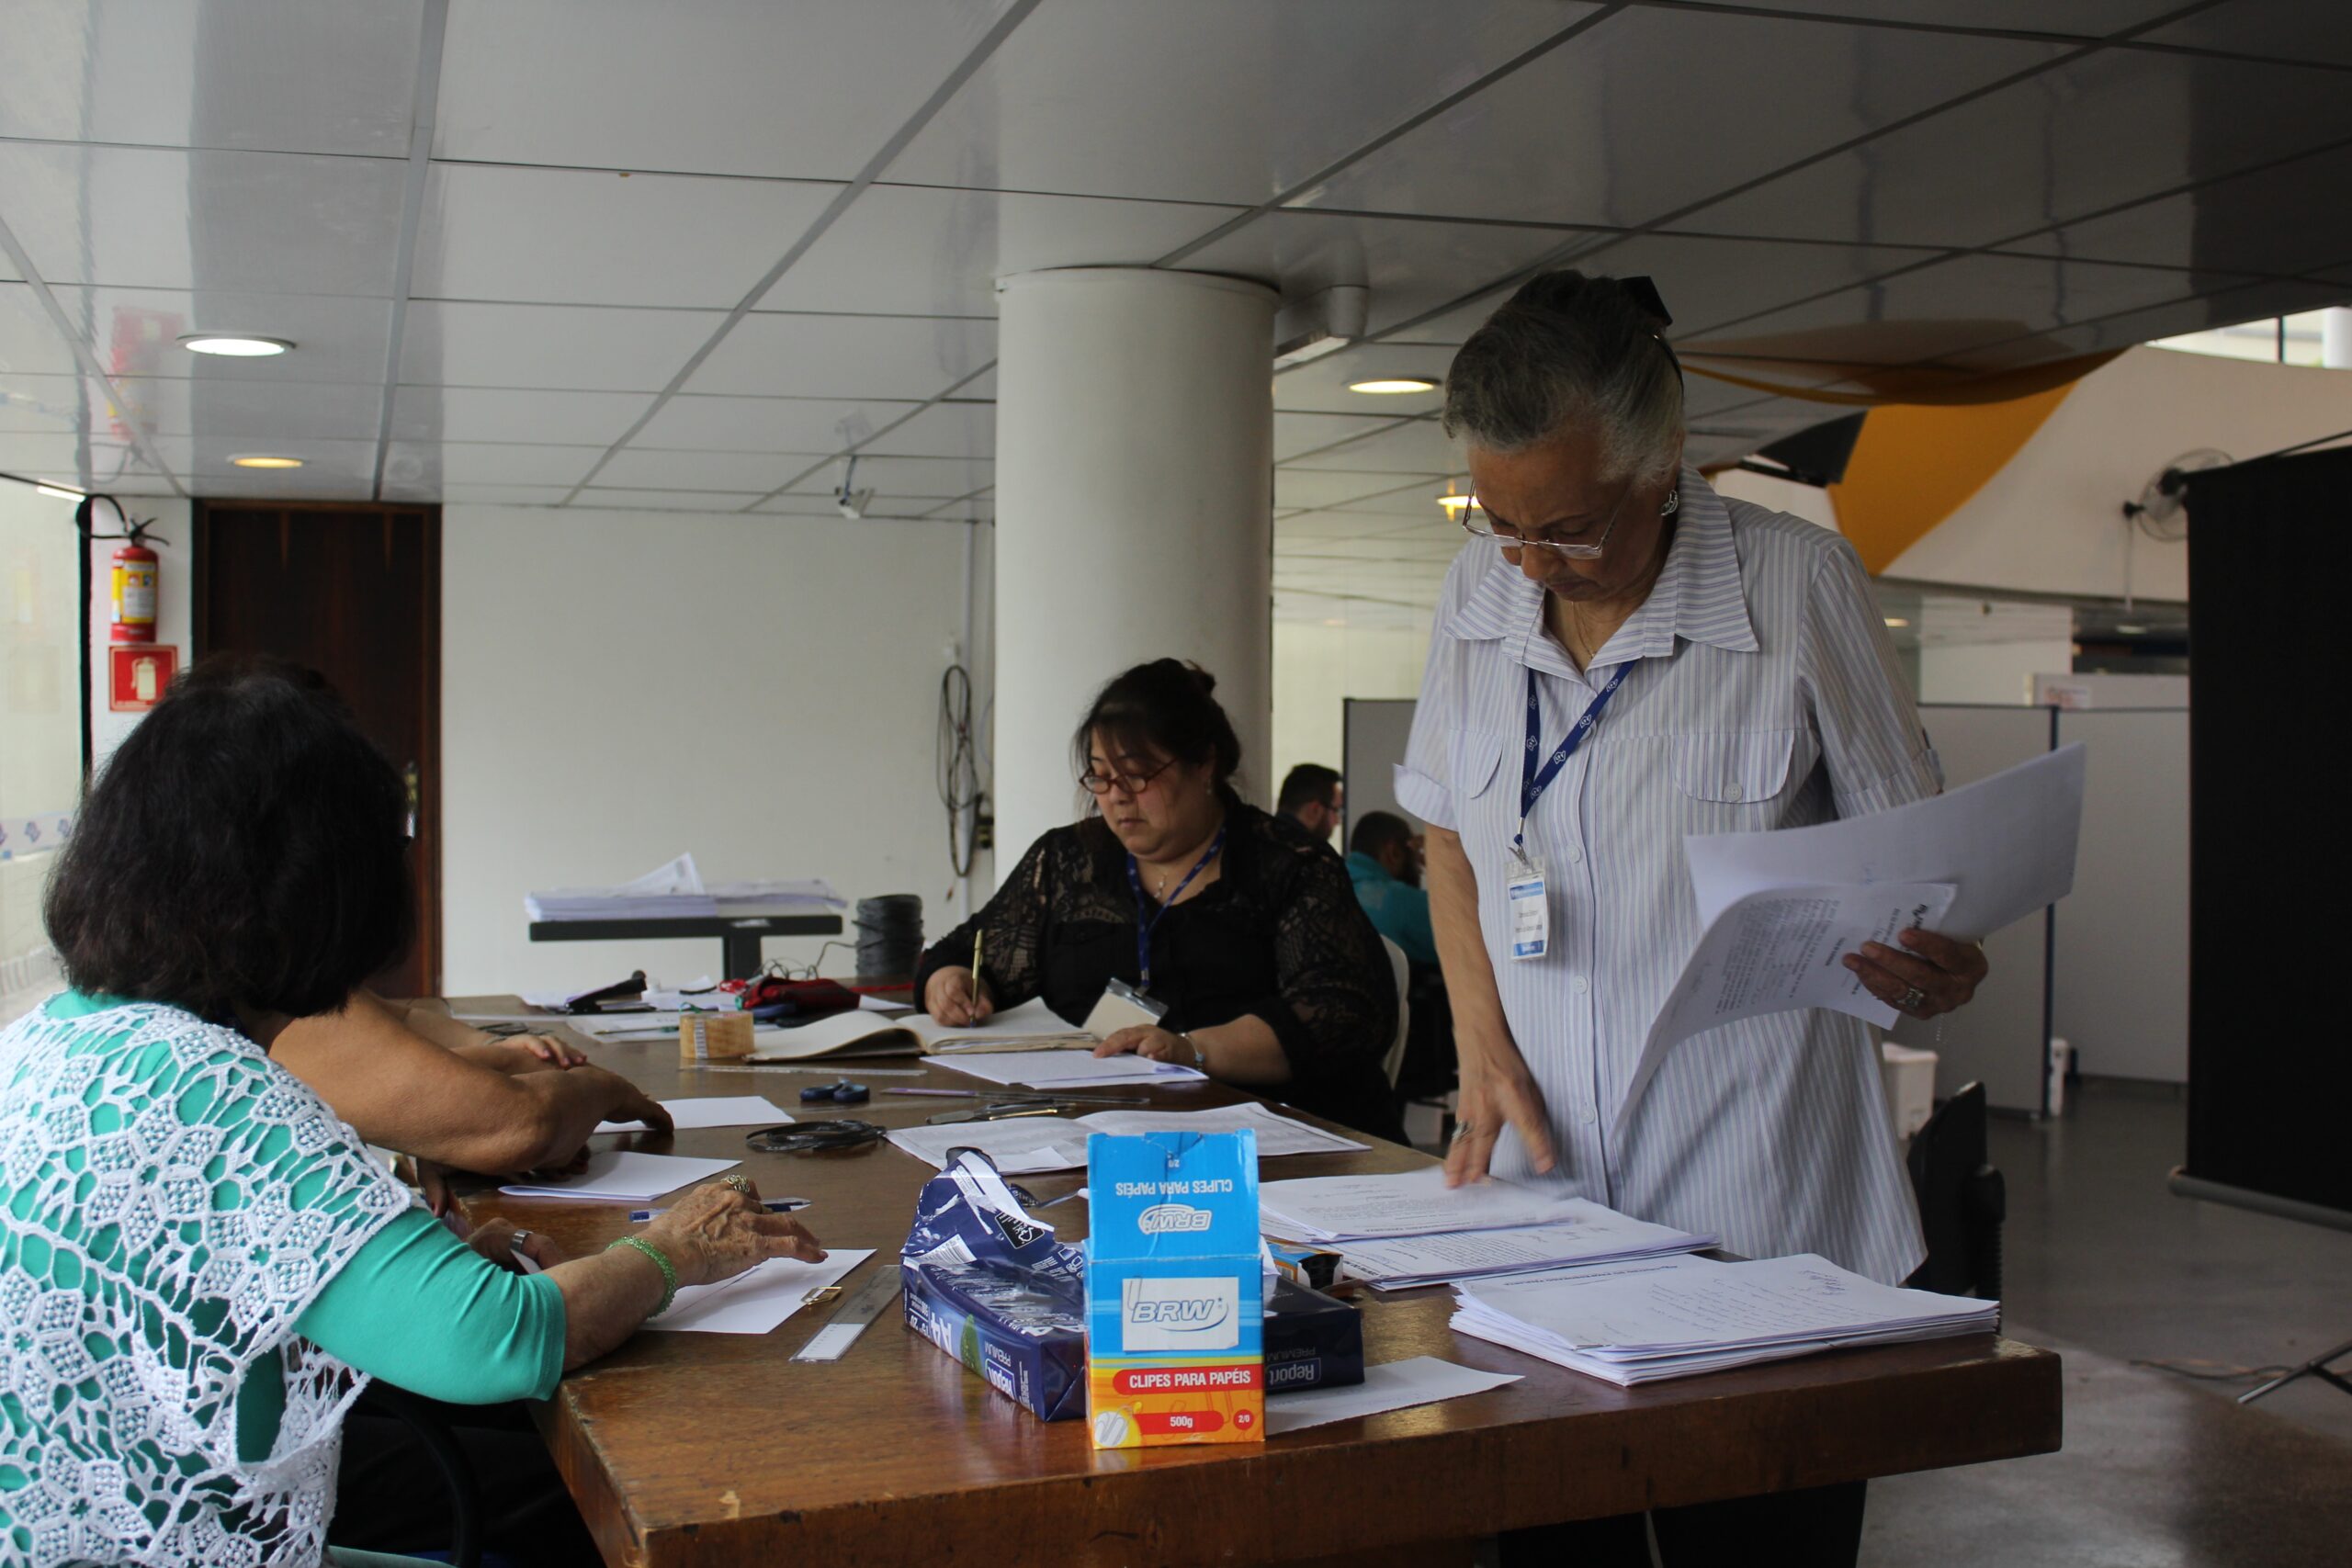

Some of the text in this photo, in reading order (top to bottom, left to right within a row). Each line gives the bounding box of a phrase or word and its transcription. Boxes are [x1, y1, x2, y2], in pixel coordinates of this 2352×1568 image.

[1115, 1179, 1233, 1199] CLIPES PARA PAPÉIS
[1150, 1212, 1210, 1230] BRW
[1131, 1299, 1215, 1324] BRW
[931, 1312, 953, 1356] A4
[984, 1341, 1012, 1367] PREMIUM
[1267, 1347, 1316, 1360] PREMIUM
[1129, 1368, 1251, 1389] CLIPES PARA PAPÉIS
[1270, 1363, 1315, 1385] Report
[1170, 1416, 1193, 1428] 500g
[1238, 1415, 1250, 1424] 2/0
